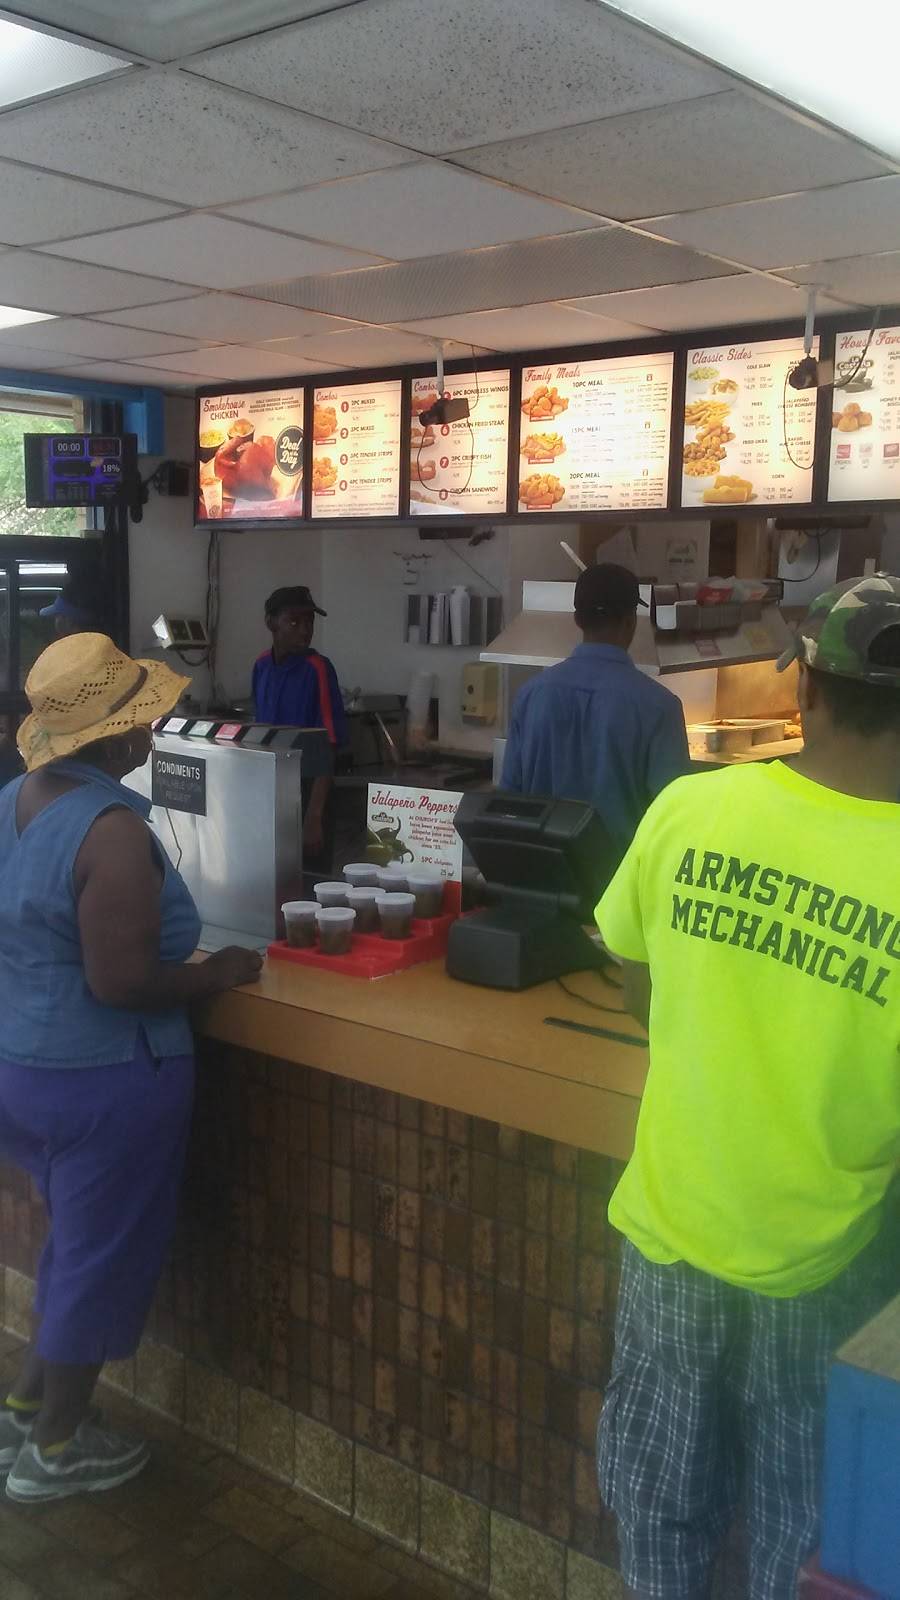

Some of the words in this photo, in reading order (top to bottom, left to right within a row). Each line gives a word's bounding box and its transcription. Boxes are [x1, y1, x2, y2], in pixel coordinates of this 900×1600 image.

[692, 349, 723, 365] Classic
[726, 348, 752, 361] Sides
[525, 368, 552, 384] Family
[556, 365, 581, 379] Meals
[203, 397, 246, 412] Smokehouse
[316, 391, 338, 402] Combos
[210, 410, 239, 420] CHICKEN
[57, 442, 80, 452] 00:00
[280, 436, 303, 450] Deal
[280, 450, 298, 469] Day
[102, 464, 120, 474] 18%
[156, 760, 200, 780] CONDIMENTS
[372, 790, 416, 810] Jalapeño
[418, 795, 458, 815] Peppers
[671, 894, 891, 1008] MECHANICAL
